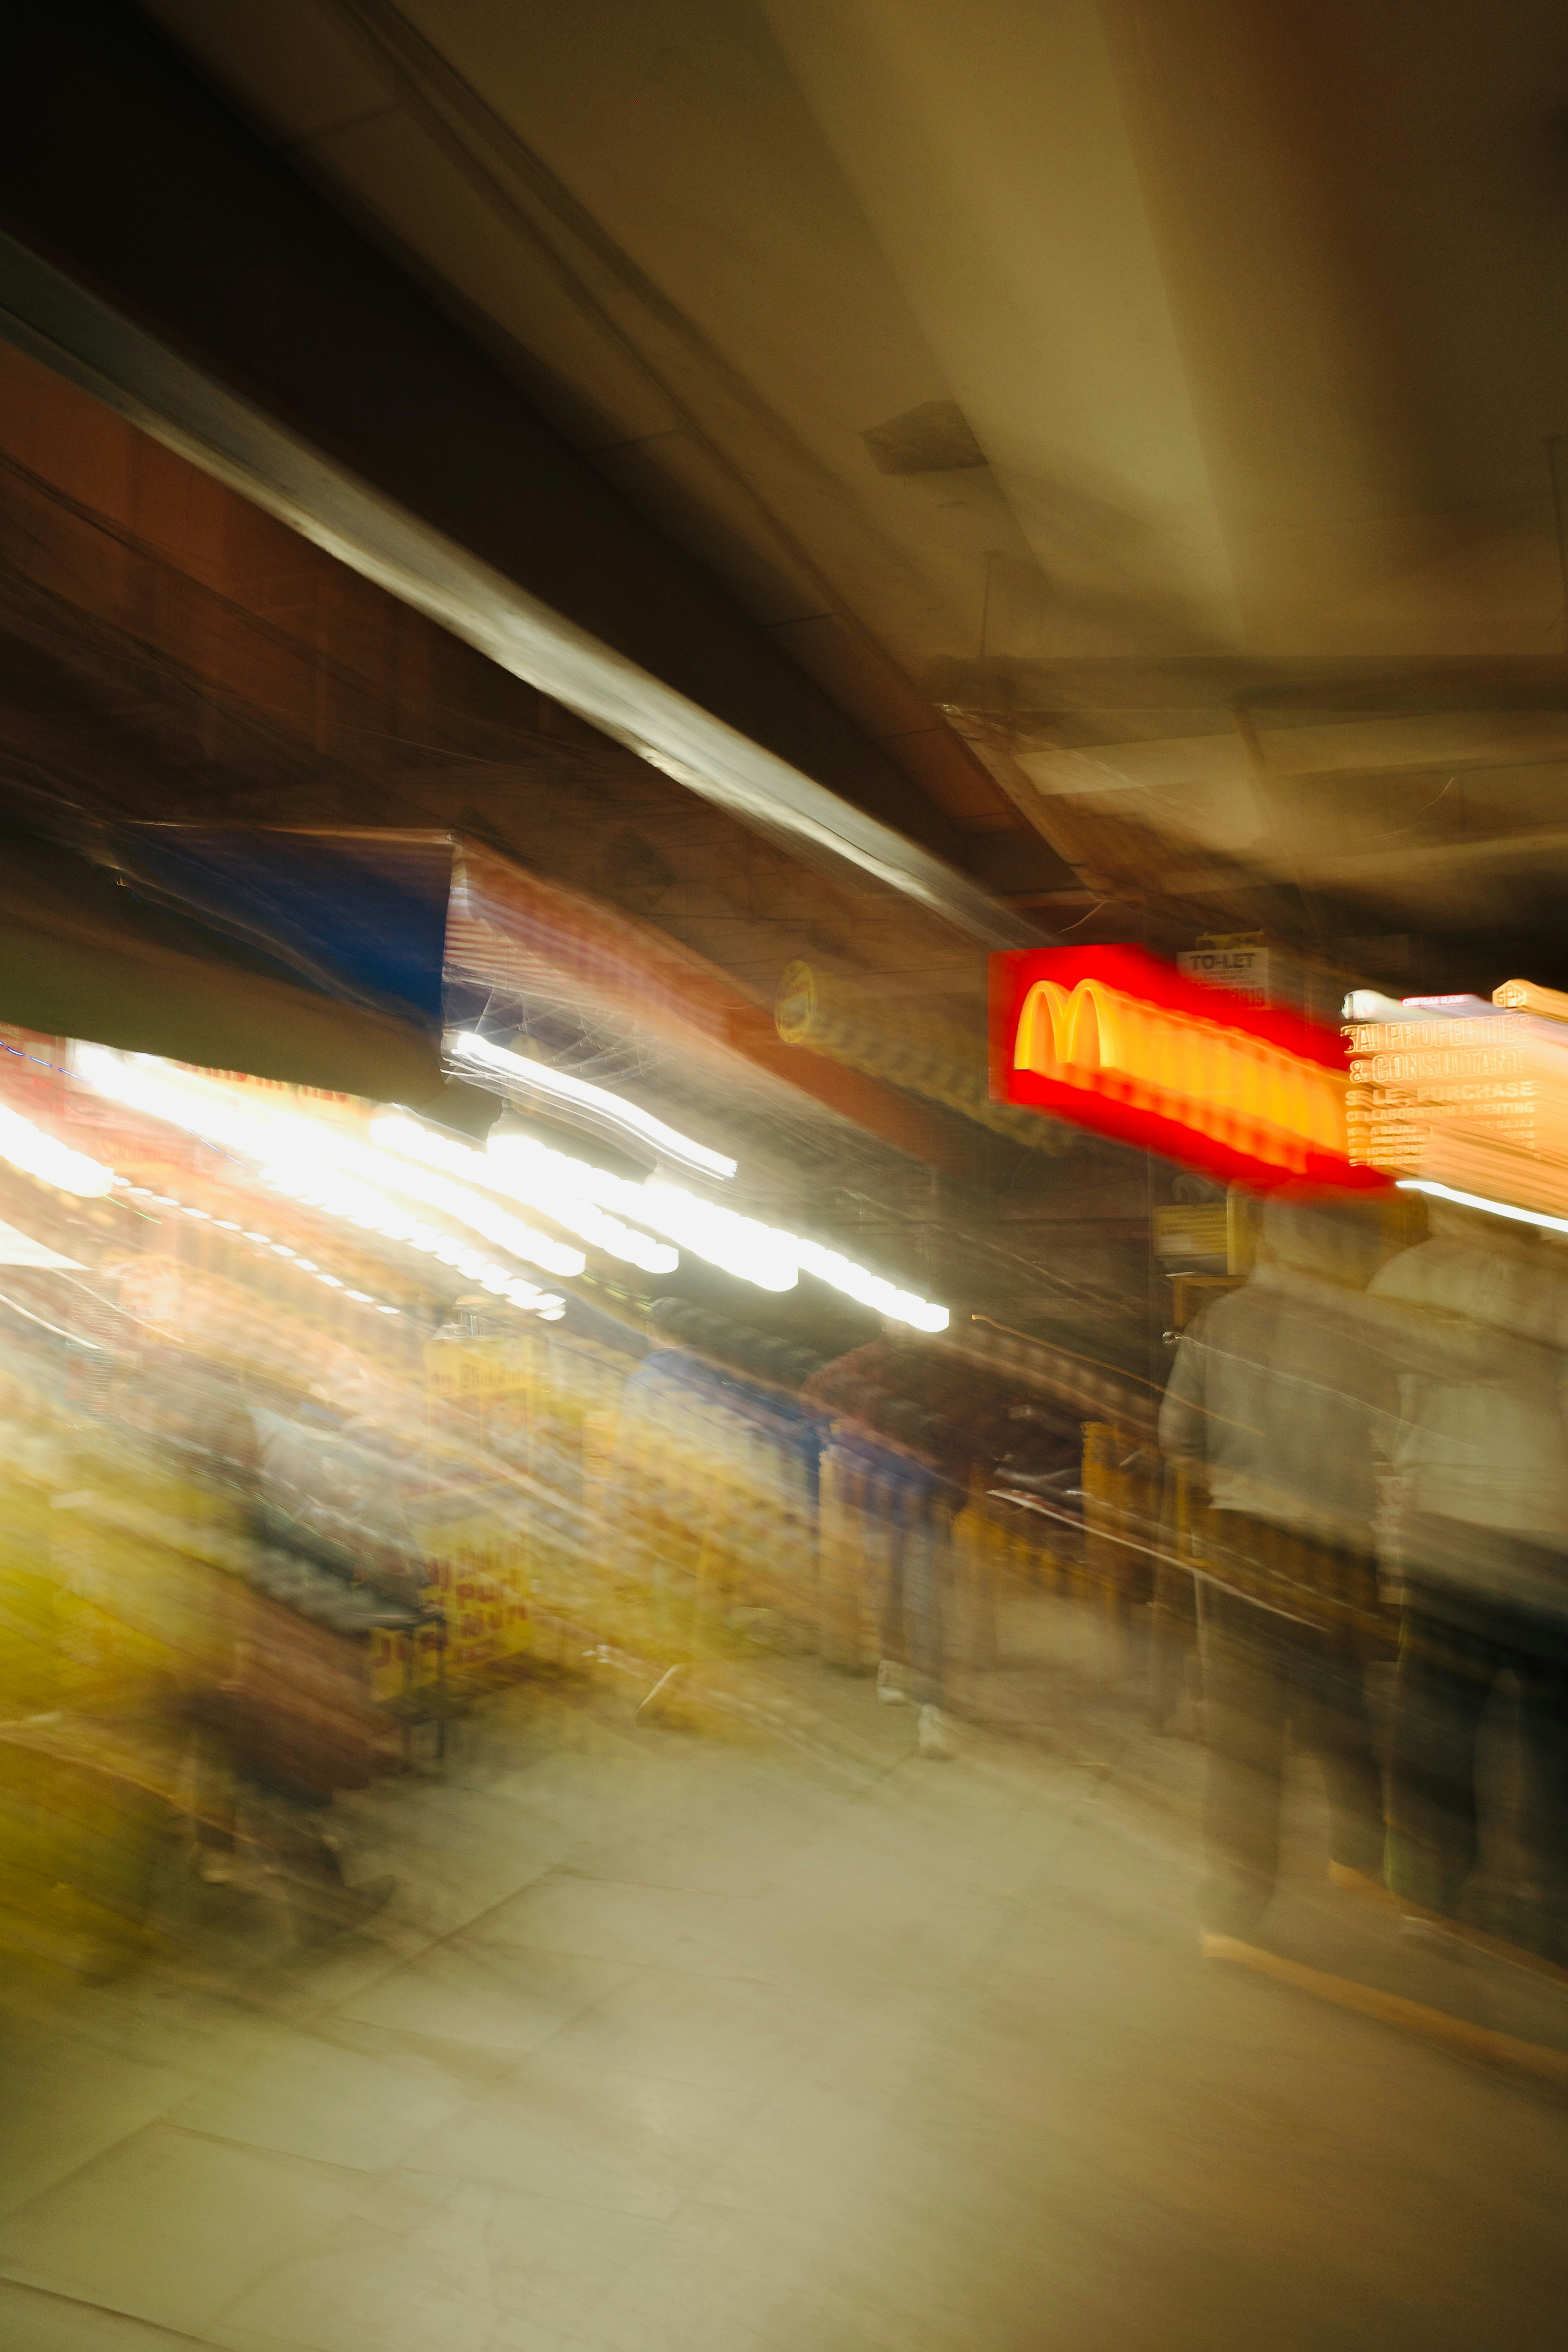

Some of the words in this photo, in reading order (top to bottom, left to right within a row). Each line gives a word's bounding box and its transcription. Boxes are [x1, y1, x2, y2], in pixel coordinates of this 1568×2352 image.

[1189, 952, 1255, 970] TO-LET
[1421, 997, 1438, 1005] SAI
[1441, 996, 1463, 1004] RAM
[1386, 1014, 1531, 1051] PROPERTIES
[1350, 1059, 1368, 1083] &
[1372, 1045, 1527, 1083] CONSULTANT
[1345, 1088, 1410, 1107] SLE,
[1417, 1081, 1534, 1102] PURCHASE
[1474, 1102, 1534, 1116] RENTING
